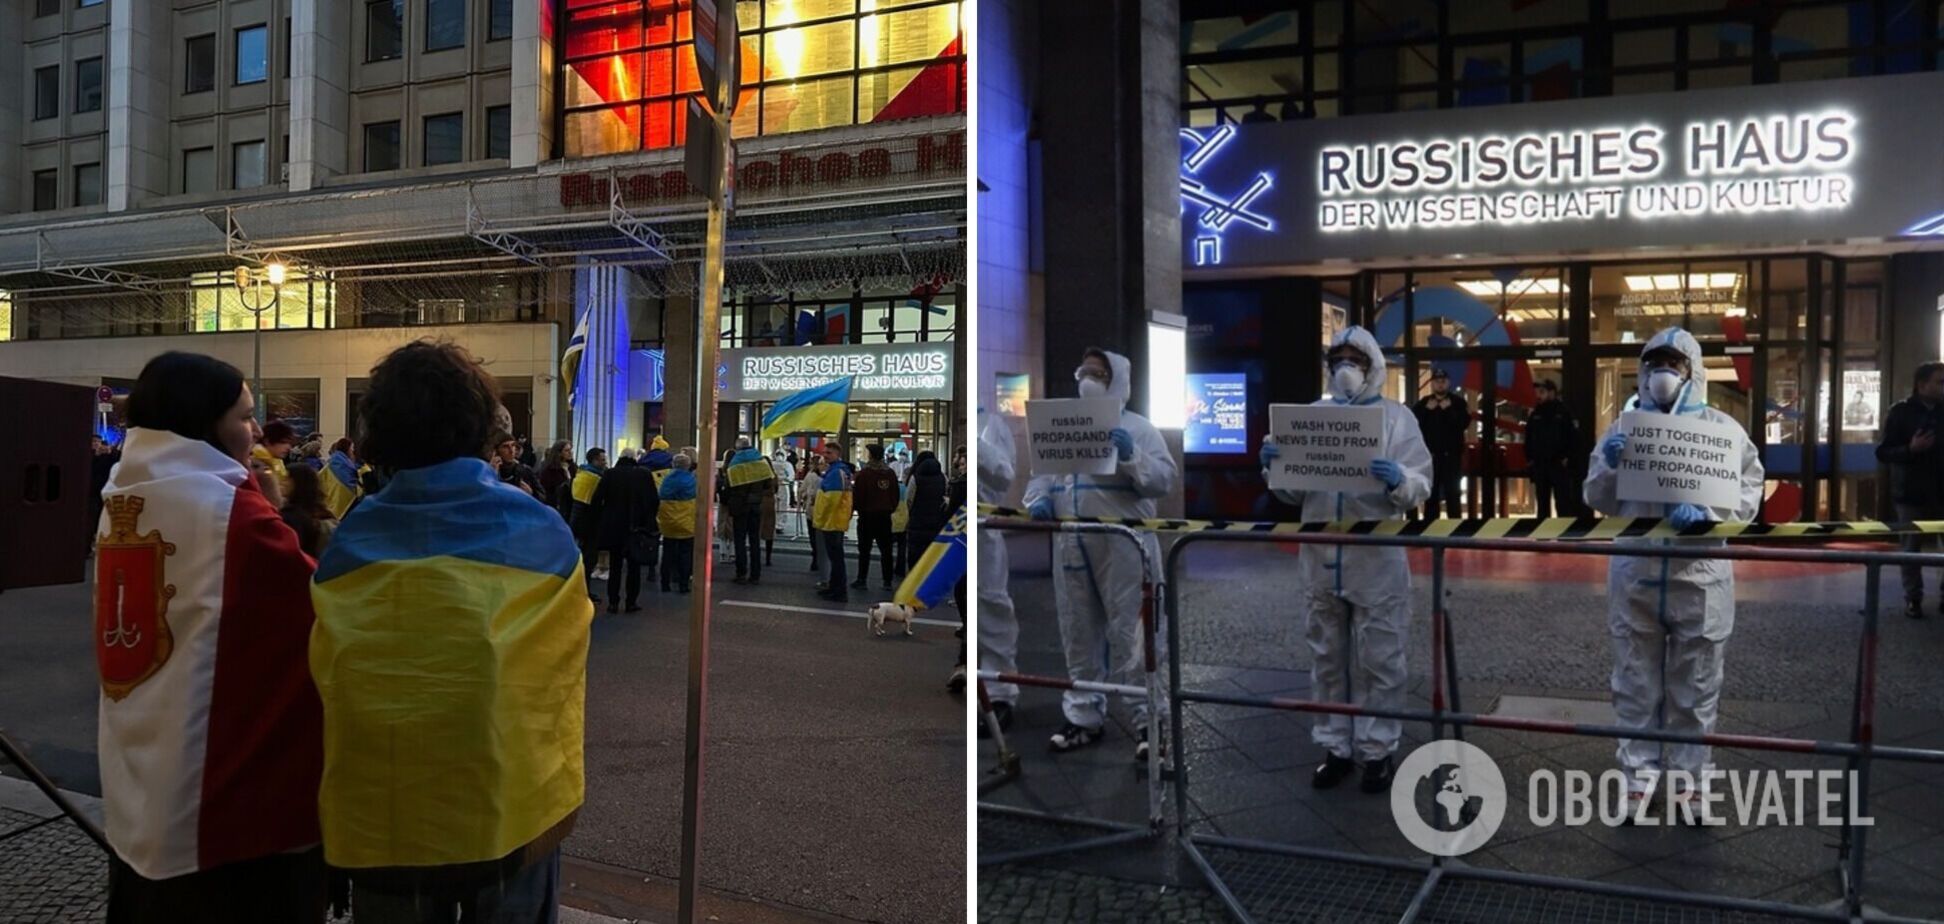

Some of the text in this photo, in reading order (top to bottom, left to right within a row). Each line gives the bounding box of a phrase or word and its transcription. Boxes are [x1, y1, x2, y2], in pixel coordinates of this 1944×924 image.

[1320, 111, 1852, 193] RUSSISCHES HAUS
[560, 147, 891, 208] Russches
[1319, 176, 1849, 230] DER WISSENSCHAFT UND KULTUR
[743, 352, 946, 376] RUSSISCHES HAUS
[743, 378, 767, 390] DER
[861, 376, 891, 389] UND
[892, 374, 945, 388] KULTUR
[1051, 415, 1093, 427] russian
[1291, 420, 1360, 432] WASH YOUR
[1275, 435, 1379, 448] NEWS FEED FROM
[1629, 426, 1733, 449] JUST TOGETHER
[1037, 448, 1073, 460] VIRUS
[1305, 451, 1345, 461] russian
[1634, 443, 1726, 463] WE CAN FIGHT
[1284, 464, 1368, 477] PROPAGANDA!
[1622, 459, 1738, 481] THE PROPAGANDA
[1657, 477, 1701, 491] VIRUS!
